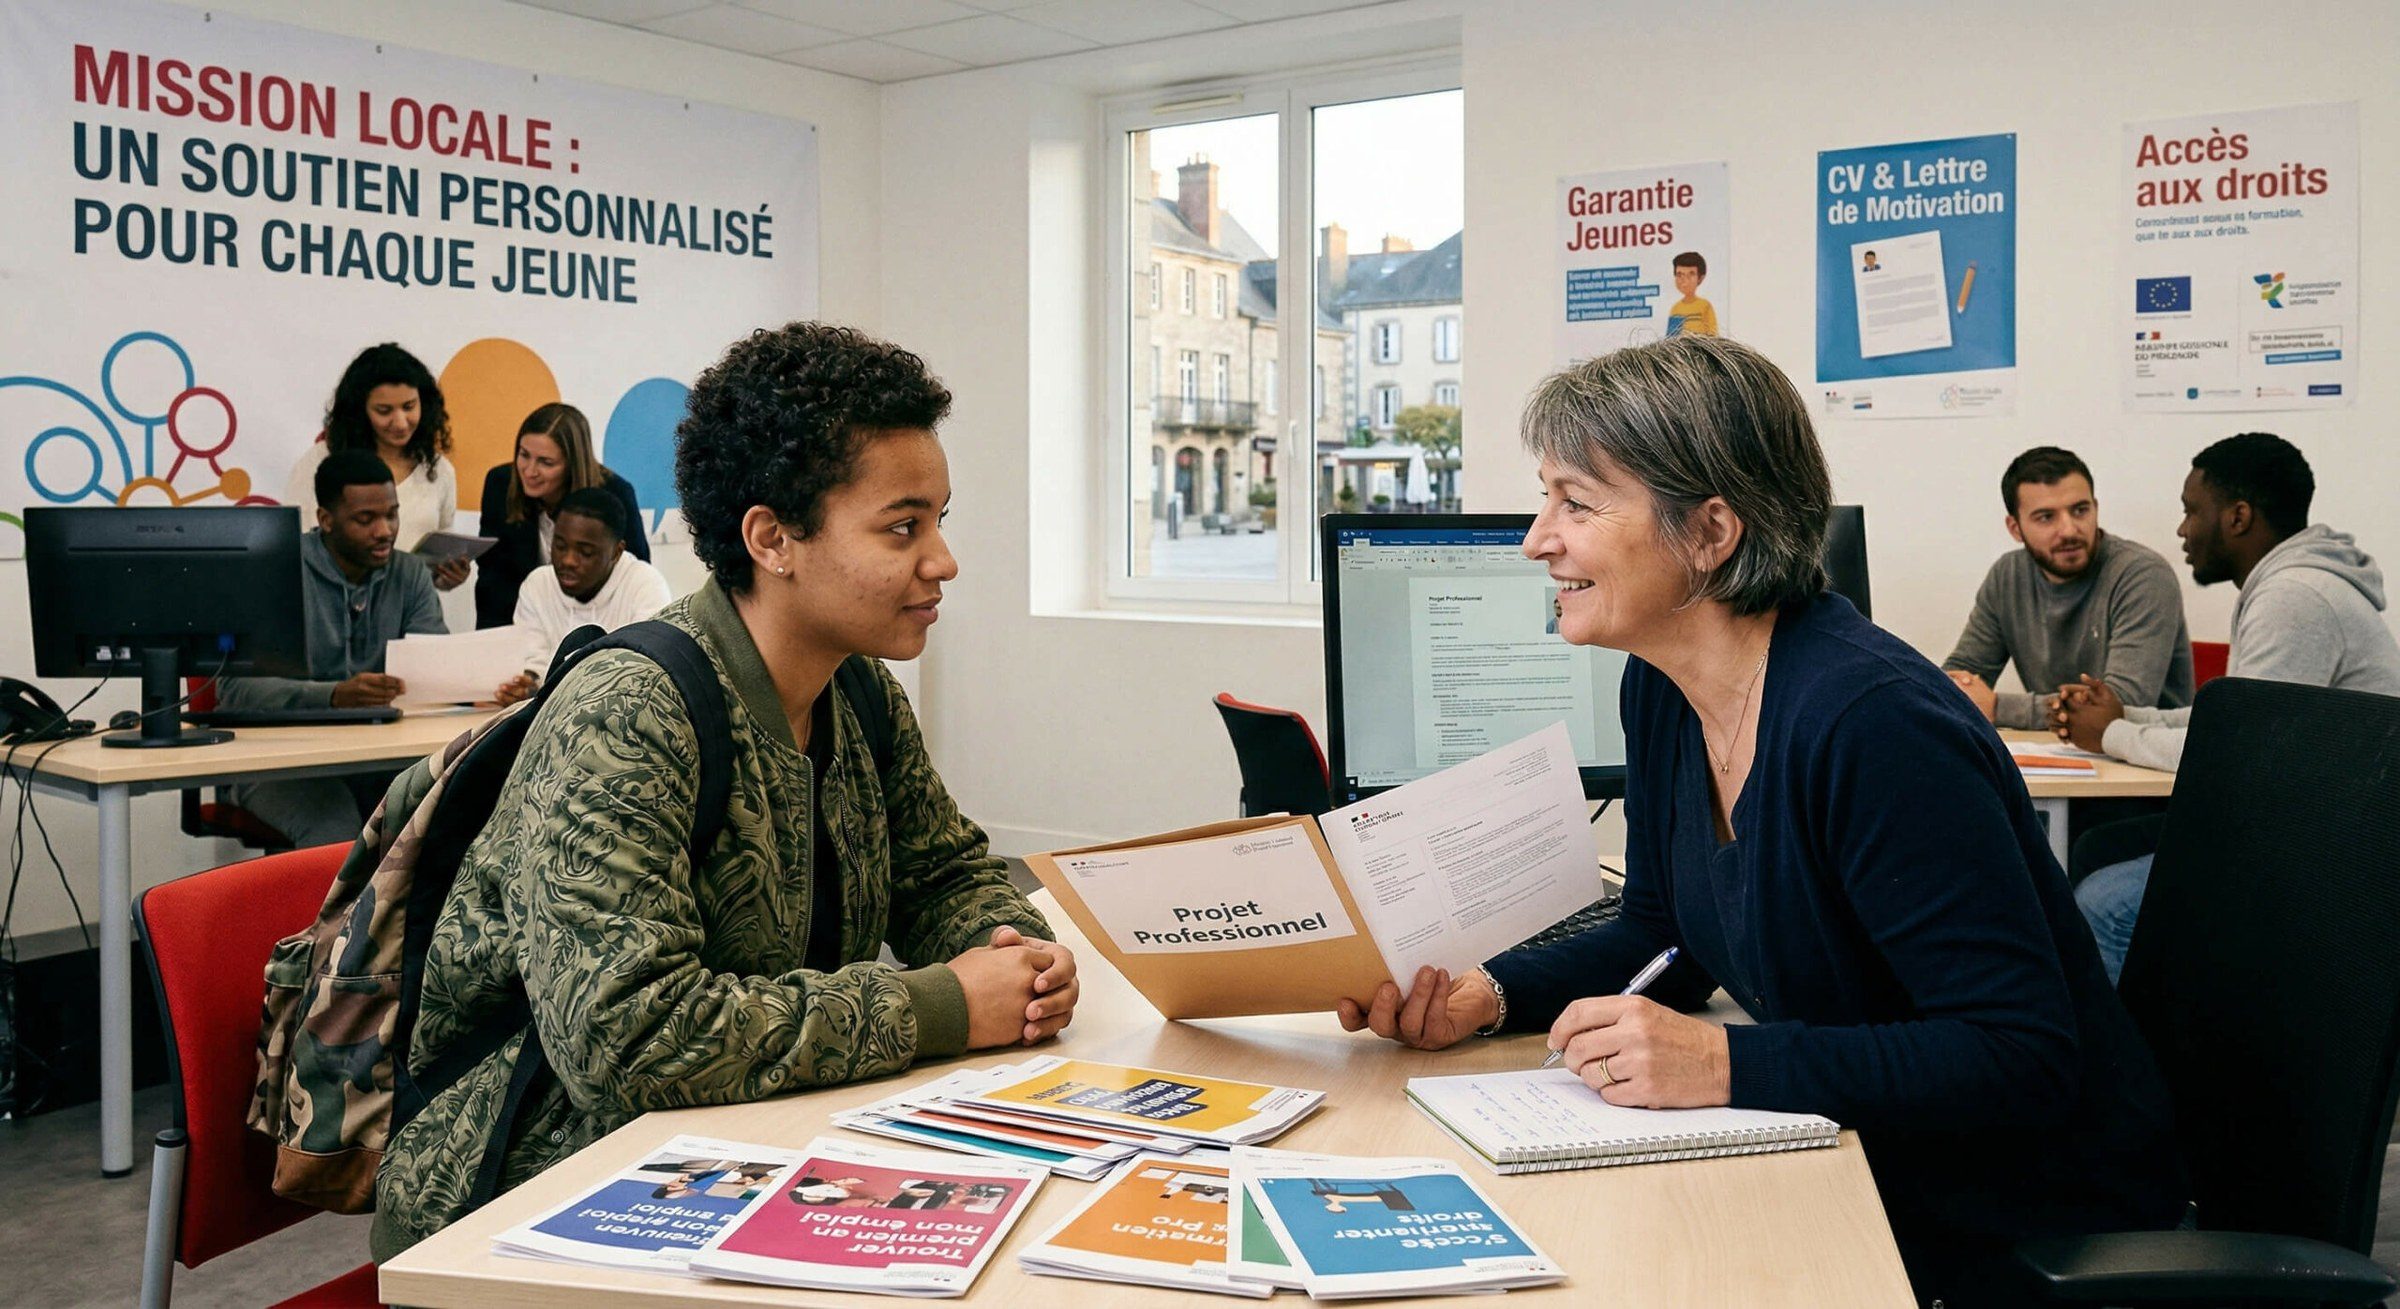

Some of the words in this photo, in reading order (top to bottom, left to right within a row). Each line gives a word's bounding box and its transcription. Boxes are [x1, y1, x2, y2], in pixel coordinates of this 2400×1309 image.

[74, 44, 336, 138] MISSION
[359, 91, 552, 170] LOCALE
[570, 138, 580, 174] :
[2136, 127, 2249, 168] Accès
[74, 121, 158, 186] UN
[181, 137, 419, 217] SOUTIEN
[440, 172, 773, 259] PERSONNALISÉ
[1828, 163, 1865, 194] CV
[1873, 161, 1895, 190] &
[1903, 156, 1987, 188] Lettre
[2137, 178, 2203, 207] aux
[2216, 162, 2329, 201] droits
[1567, 178, 1694, 217] Garantie
[1828, 199, 1858, 225] de
[1866, 189, 2004, 223] Motivation
[75, 198, 238, 268] POUR
[261, 219, 475, 289] CHAQUE
[492, 245, 637, 304] JEUNE
[1566, 221, 1673, 252] Jeunes
[1133, 912, 1328, 944] Professionnel
[1172, 900, 1263, 923] Projet
[916, 1221, 985, 1234] mon
[1152, 1216, 1204, 1231] Pro
[846, 1243, 964, 1260] Trouver
